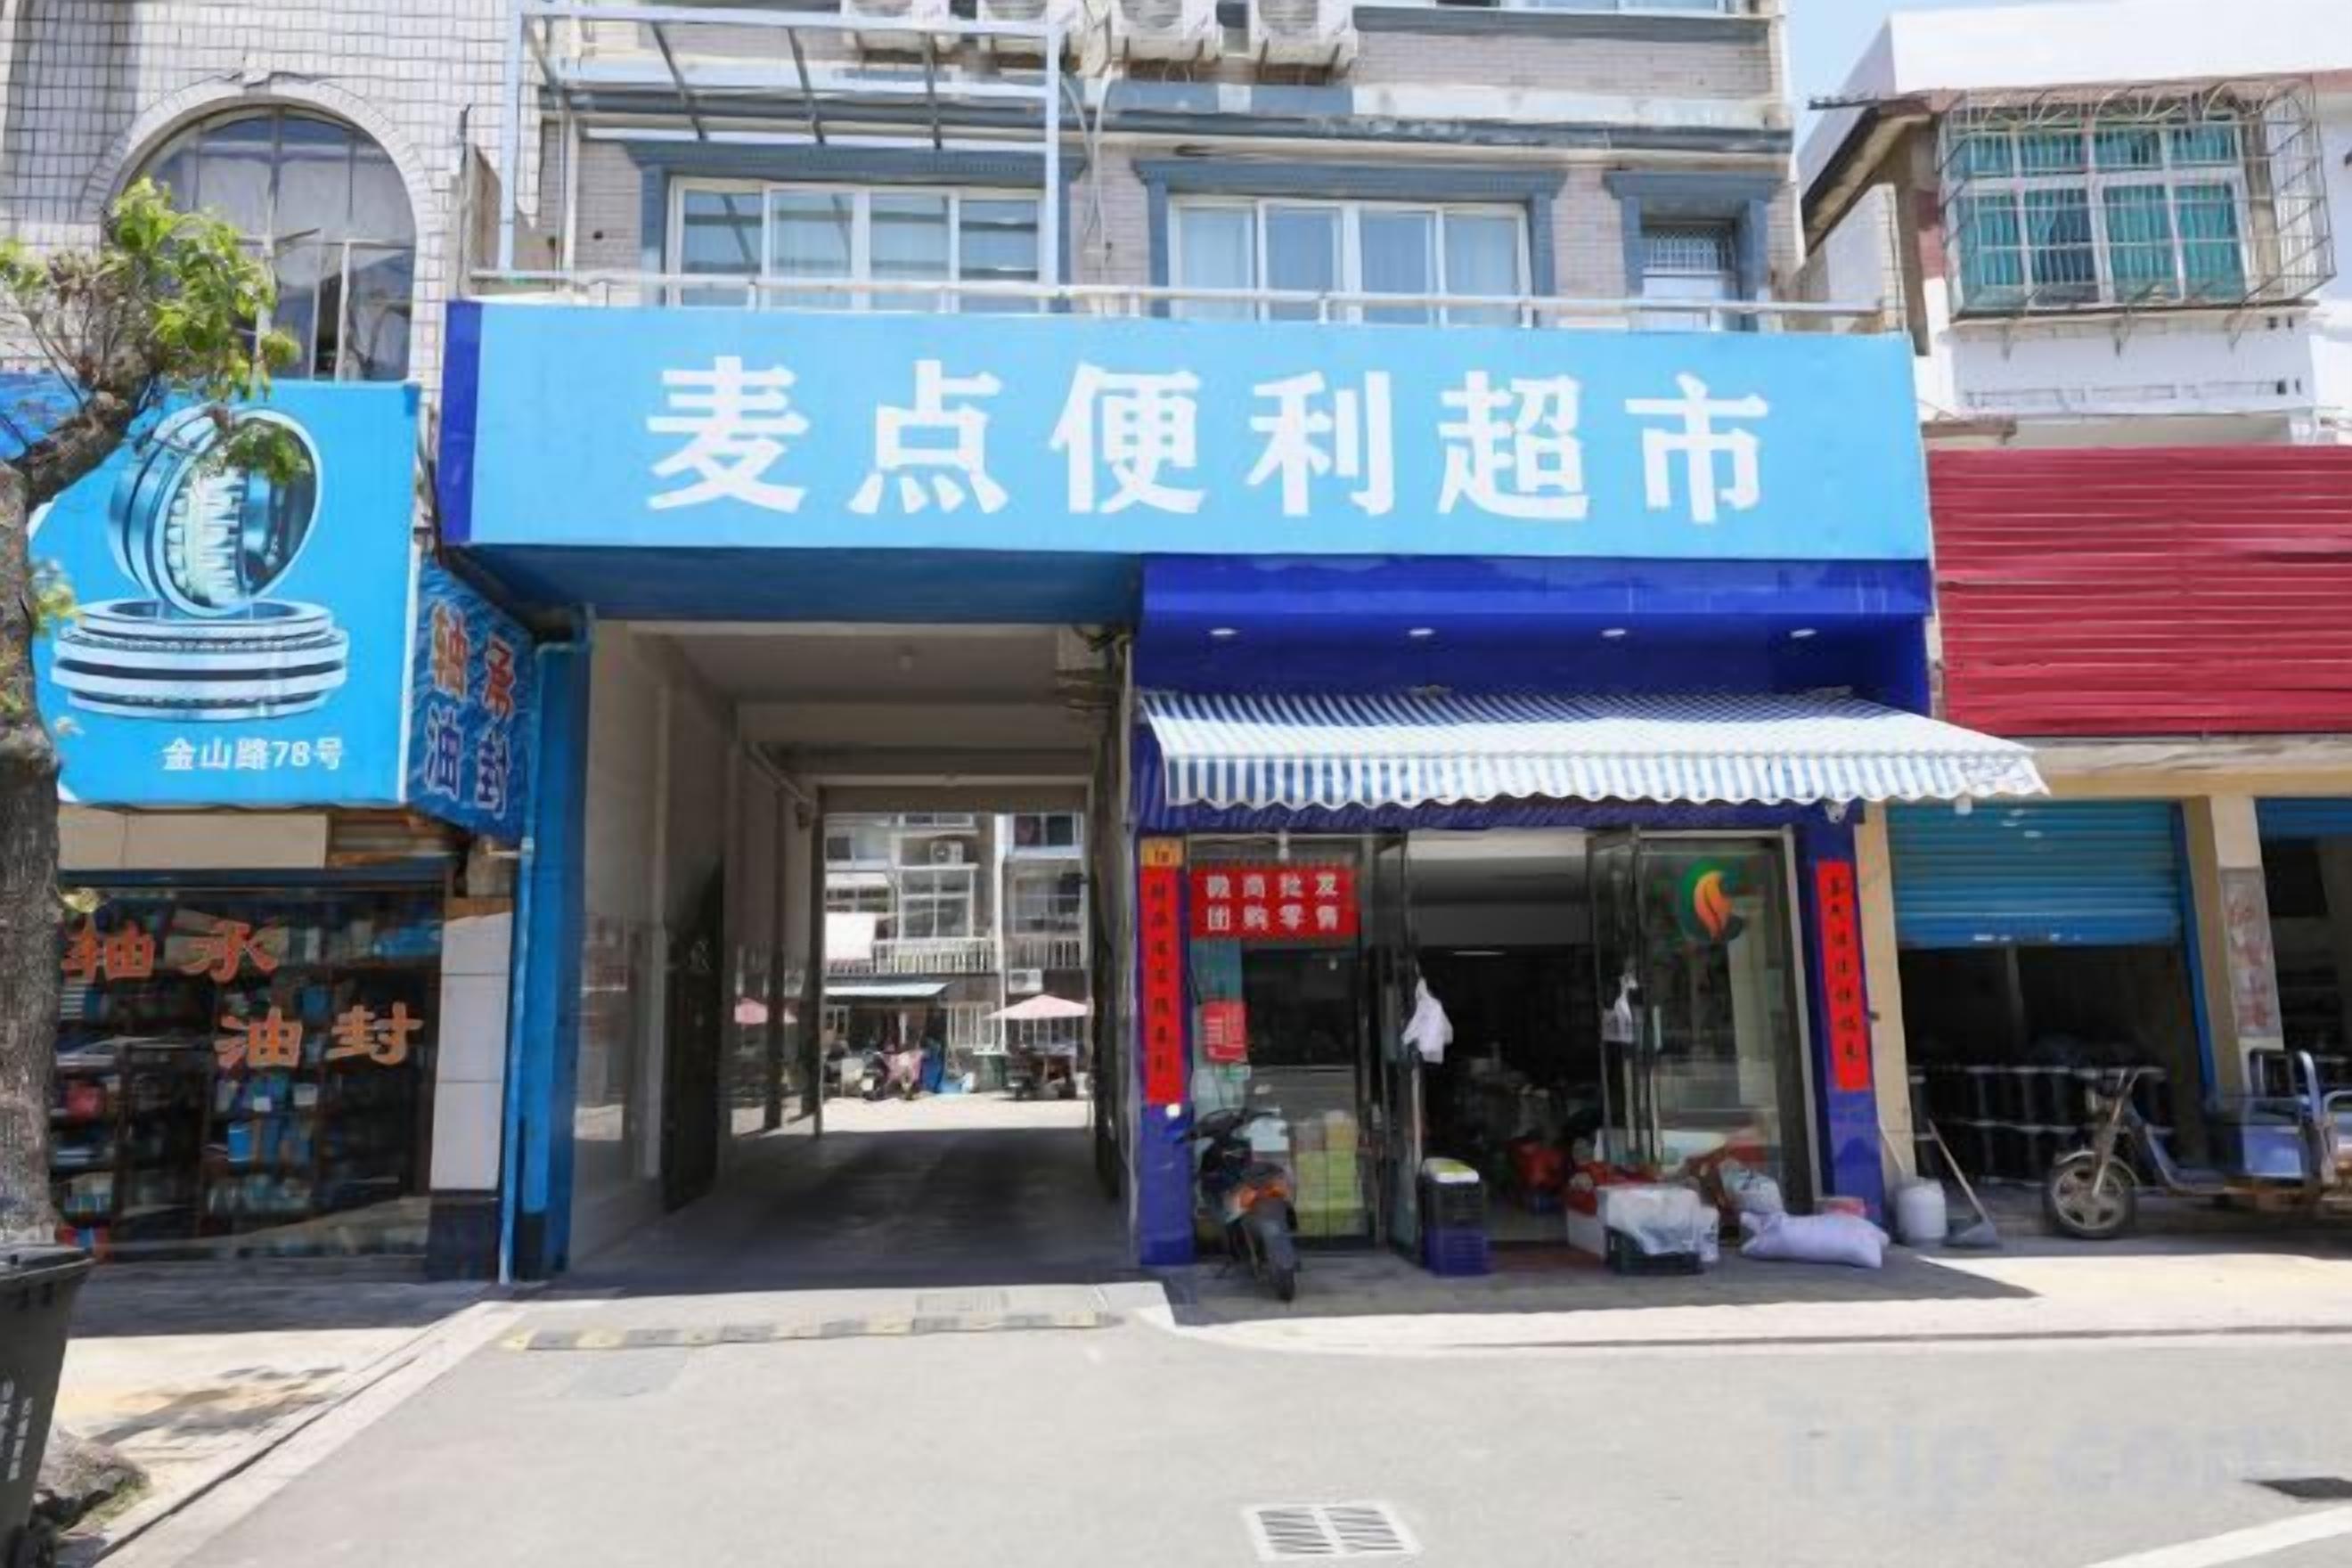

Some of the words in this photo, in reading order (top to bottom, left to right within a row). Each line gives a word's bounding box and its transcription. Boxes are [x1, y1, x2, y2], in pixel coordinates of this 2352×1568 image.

[645, 355, 1769, 525] 麦点便利超市
[161, 737, 343, 771] 金山路78号
[216, 1000, 424, 1069] 油封
